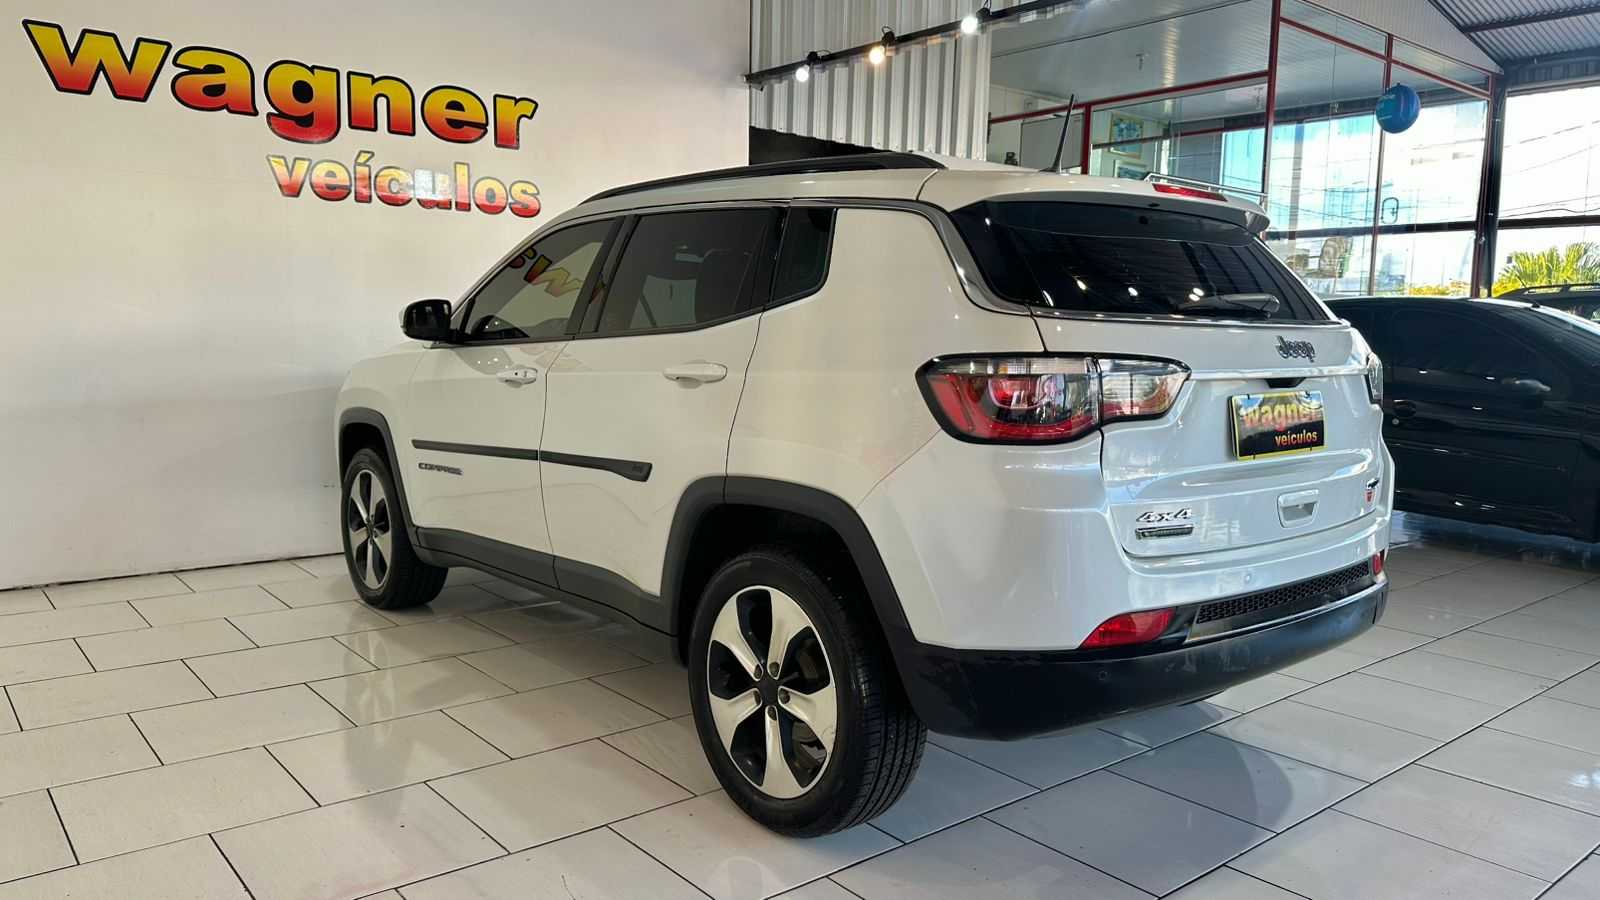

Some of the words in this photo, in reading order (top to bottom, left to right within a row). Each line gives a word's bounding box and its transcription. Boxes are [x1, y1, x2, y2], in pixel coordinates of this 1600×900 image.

[22, 18, 538, 150] wagner
[267, 150, 541, 218] veículos
[1275, 335, 1316, 363] Jeep
[1135, 507, 1192, 523] 4x4
